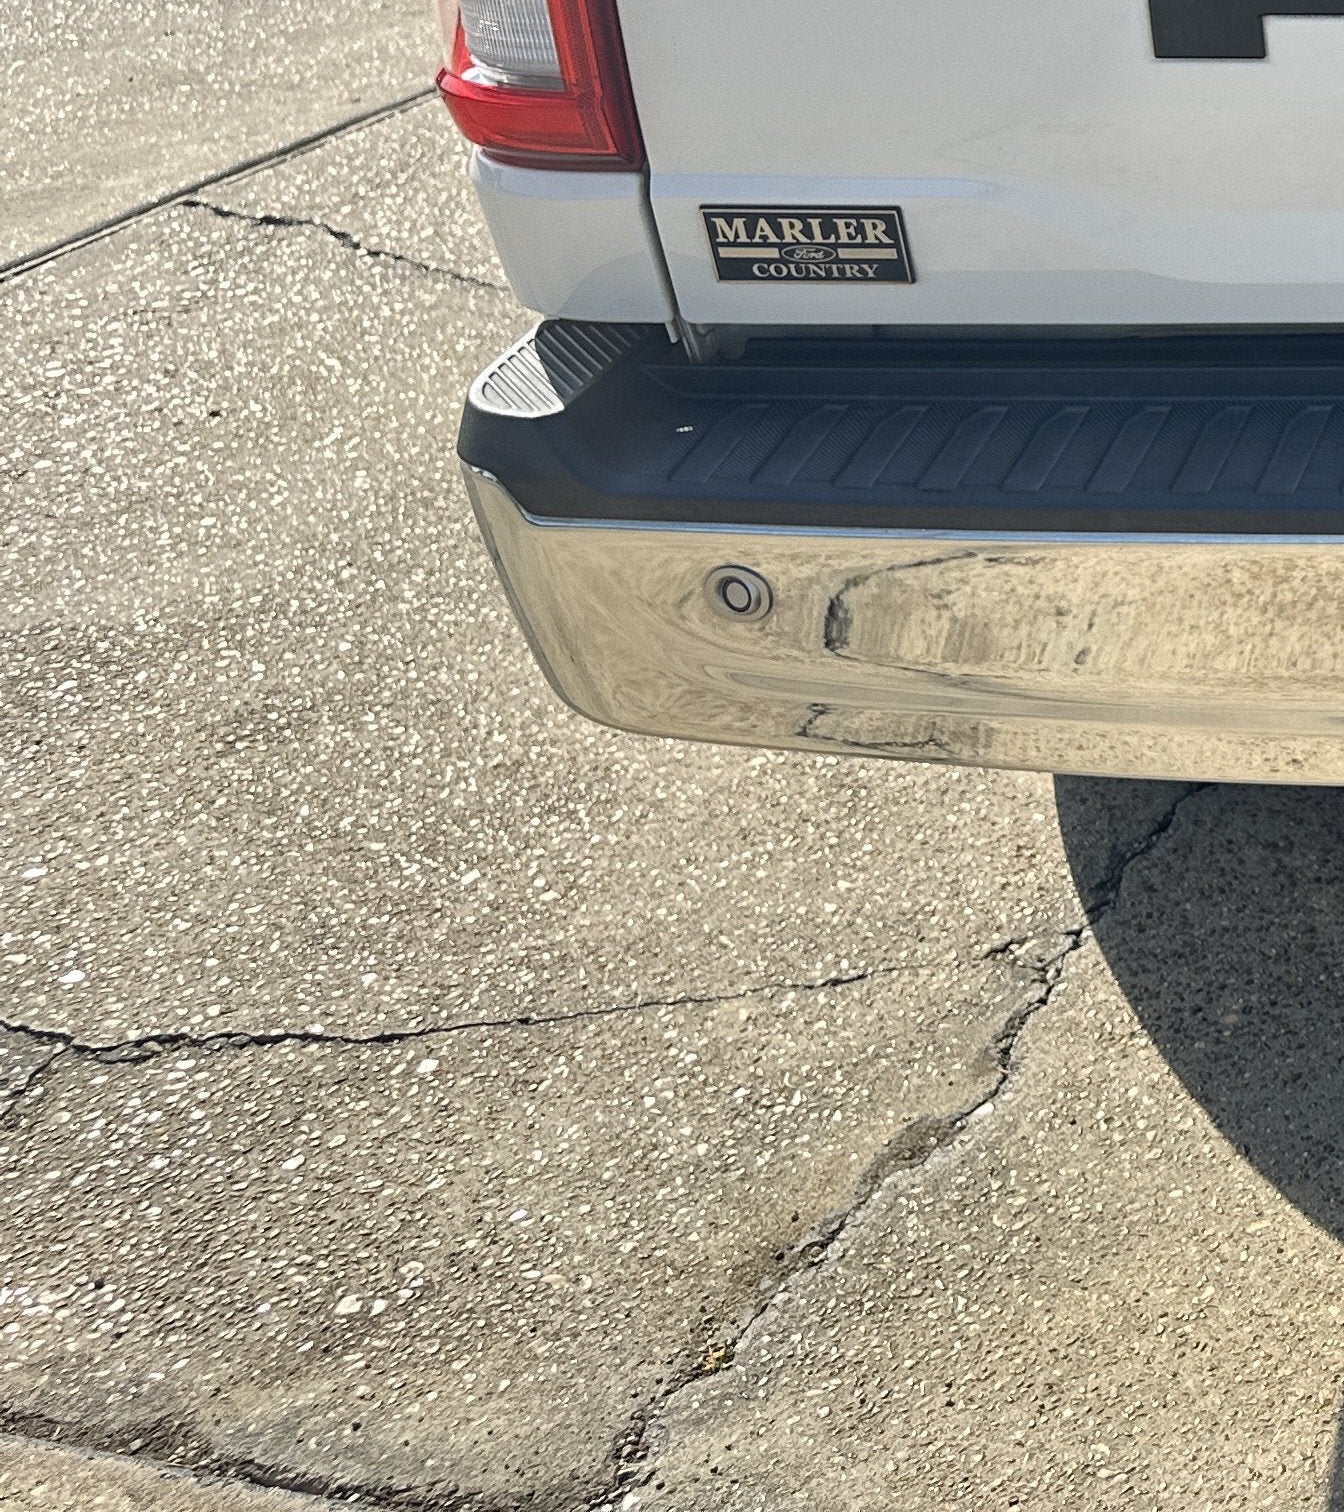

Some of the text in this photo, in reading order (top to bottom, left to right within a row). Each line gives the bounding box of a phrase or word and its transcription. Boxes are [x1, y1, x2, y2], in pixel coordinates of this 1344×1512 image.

[711, 217, 895, 244] MARLER
[793, 246, 825, 260] Ford
[752, 263, 879, 279] COUNTRY
